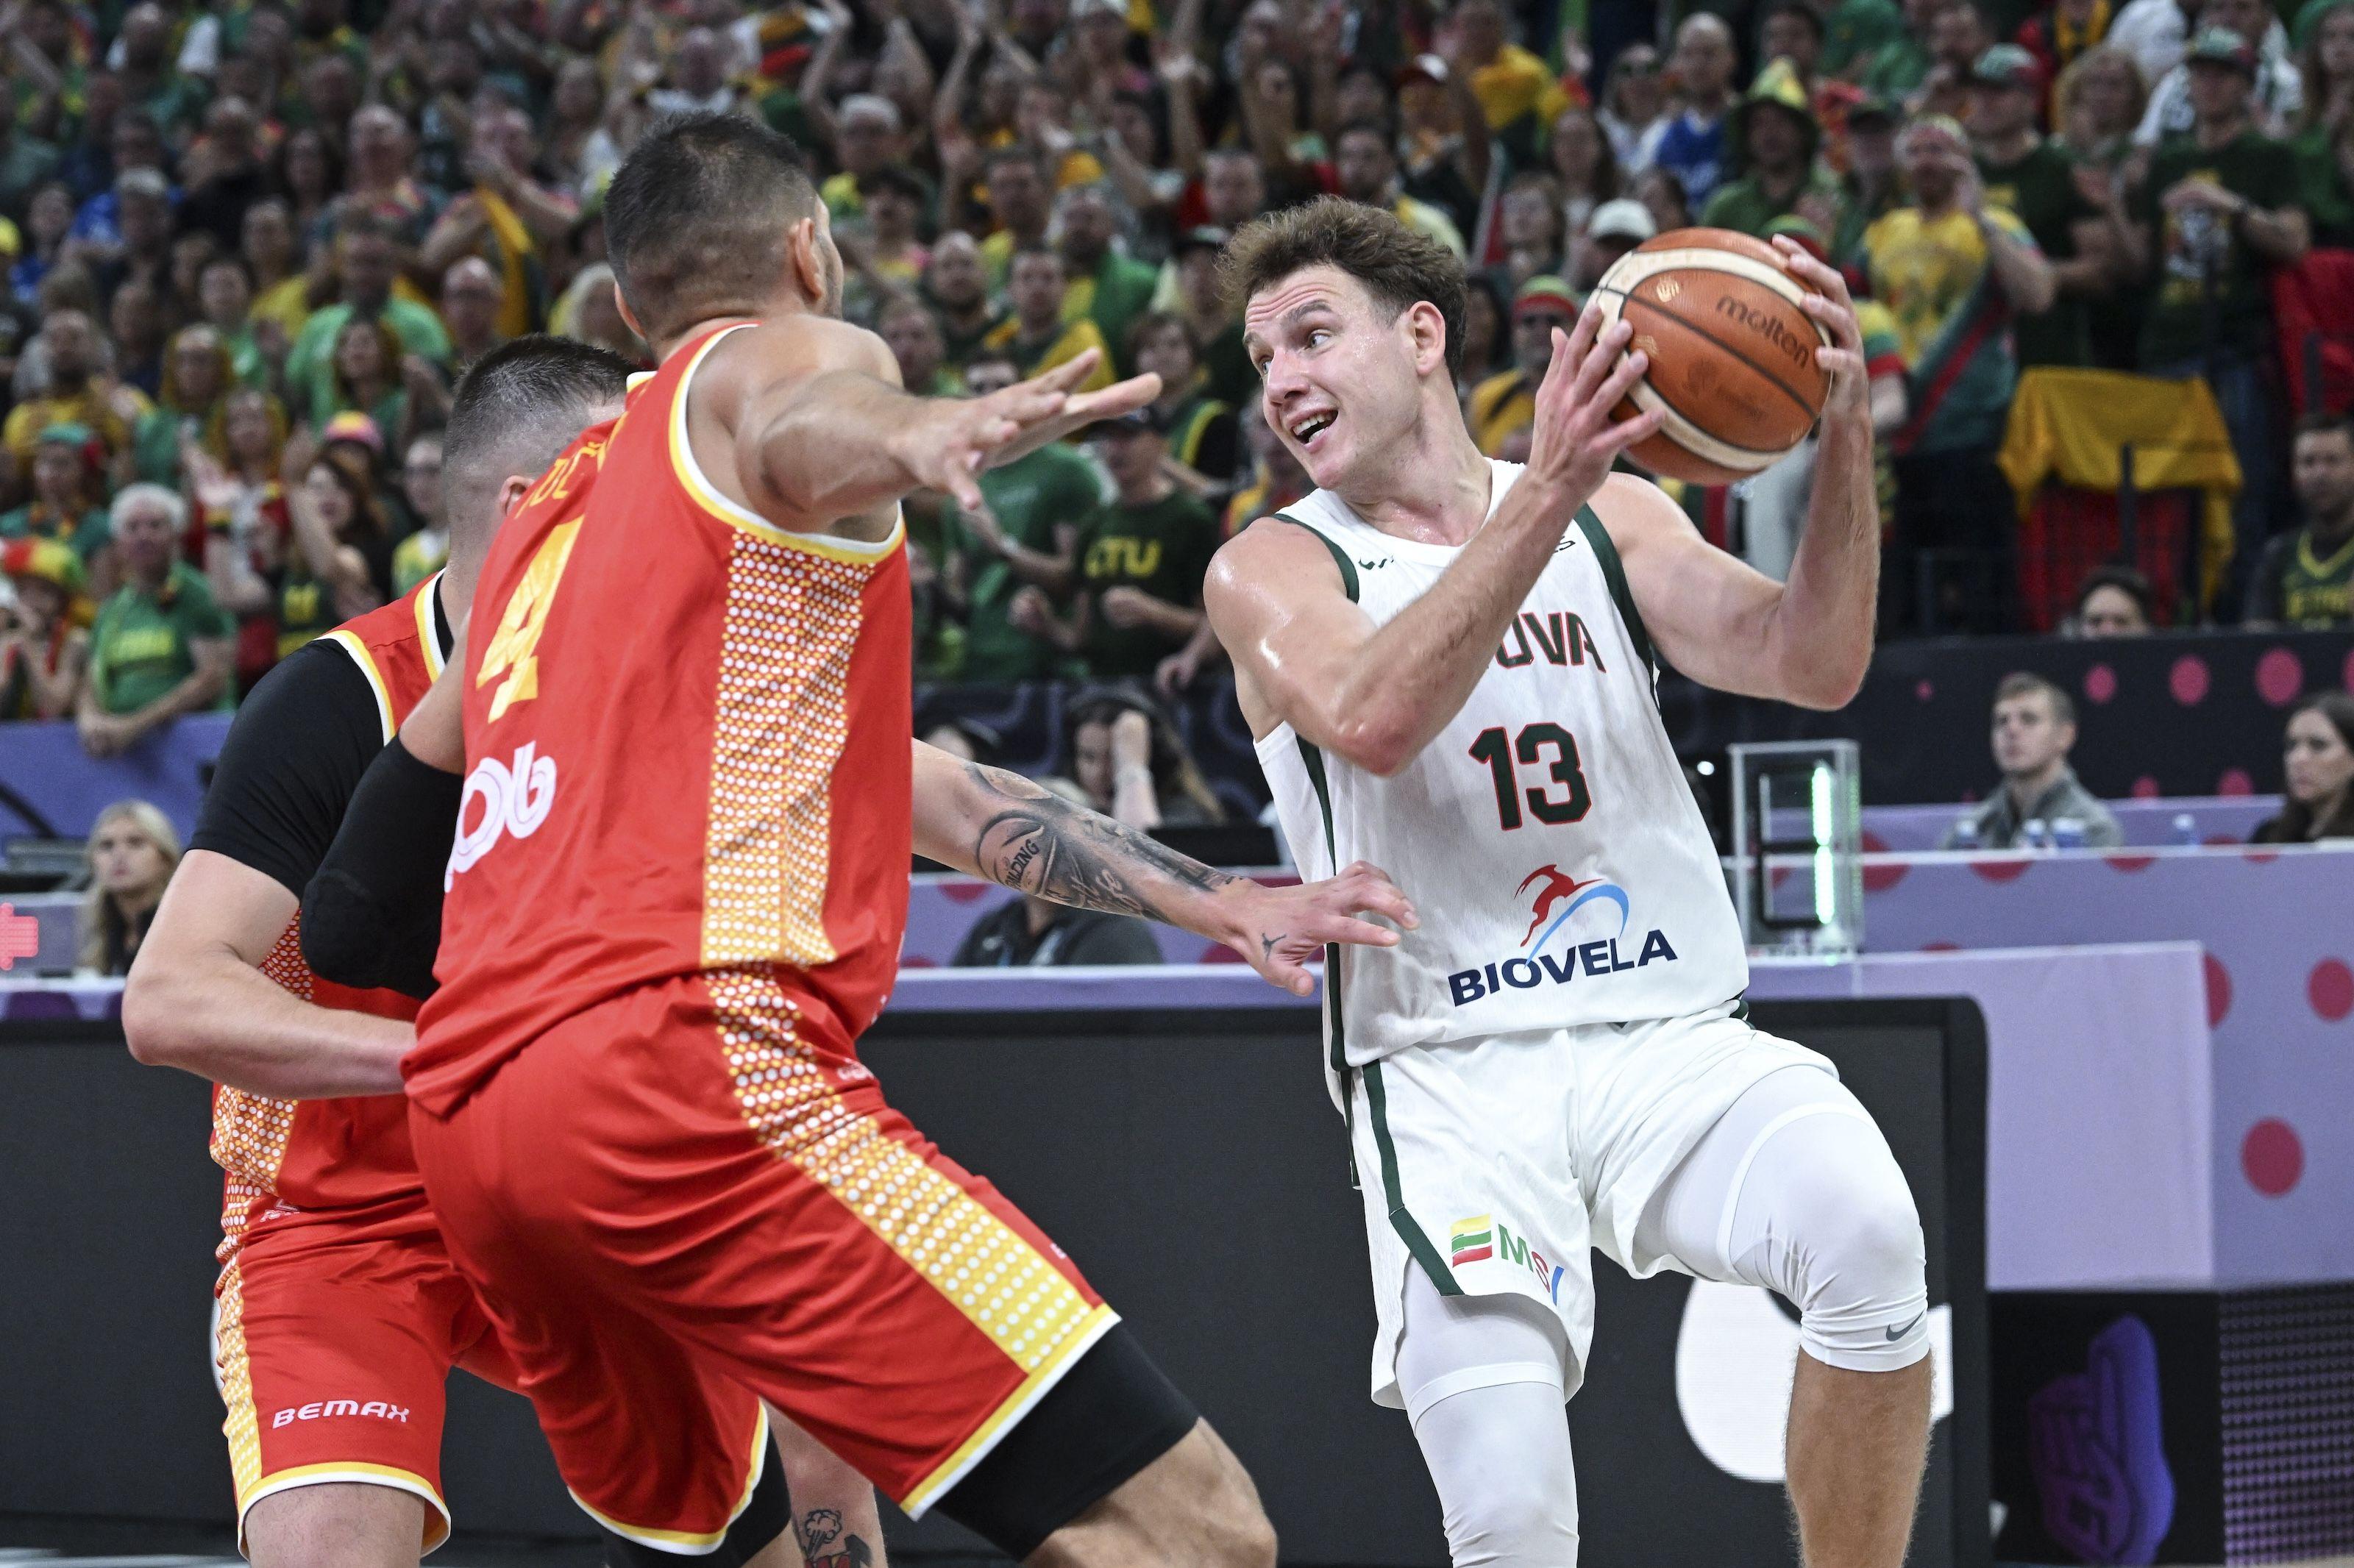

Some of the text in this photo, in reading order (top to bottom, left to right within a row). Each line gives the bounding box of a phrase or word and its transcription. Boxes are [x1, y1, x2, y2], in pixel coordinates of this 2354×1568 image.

[1715, 294, 1810, 368] molten
[475, 514, 585, 725] 4
[1493, 611, 1607, 674] UVA
[1468, 721, 1592, 831] 13
[1448, 929, 1679, 1008] BIOVELA
[271, 1400, 410, 1430] BEMAX
